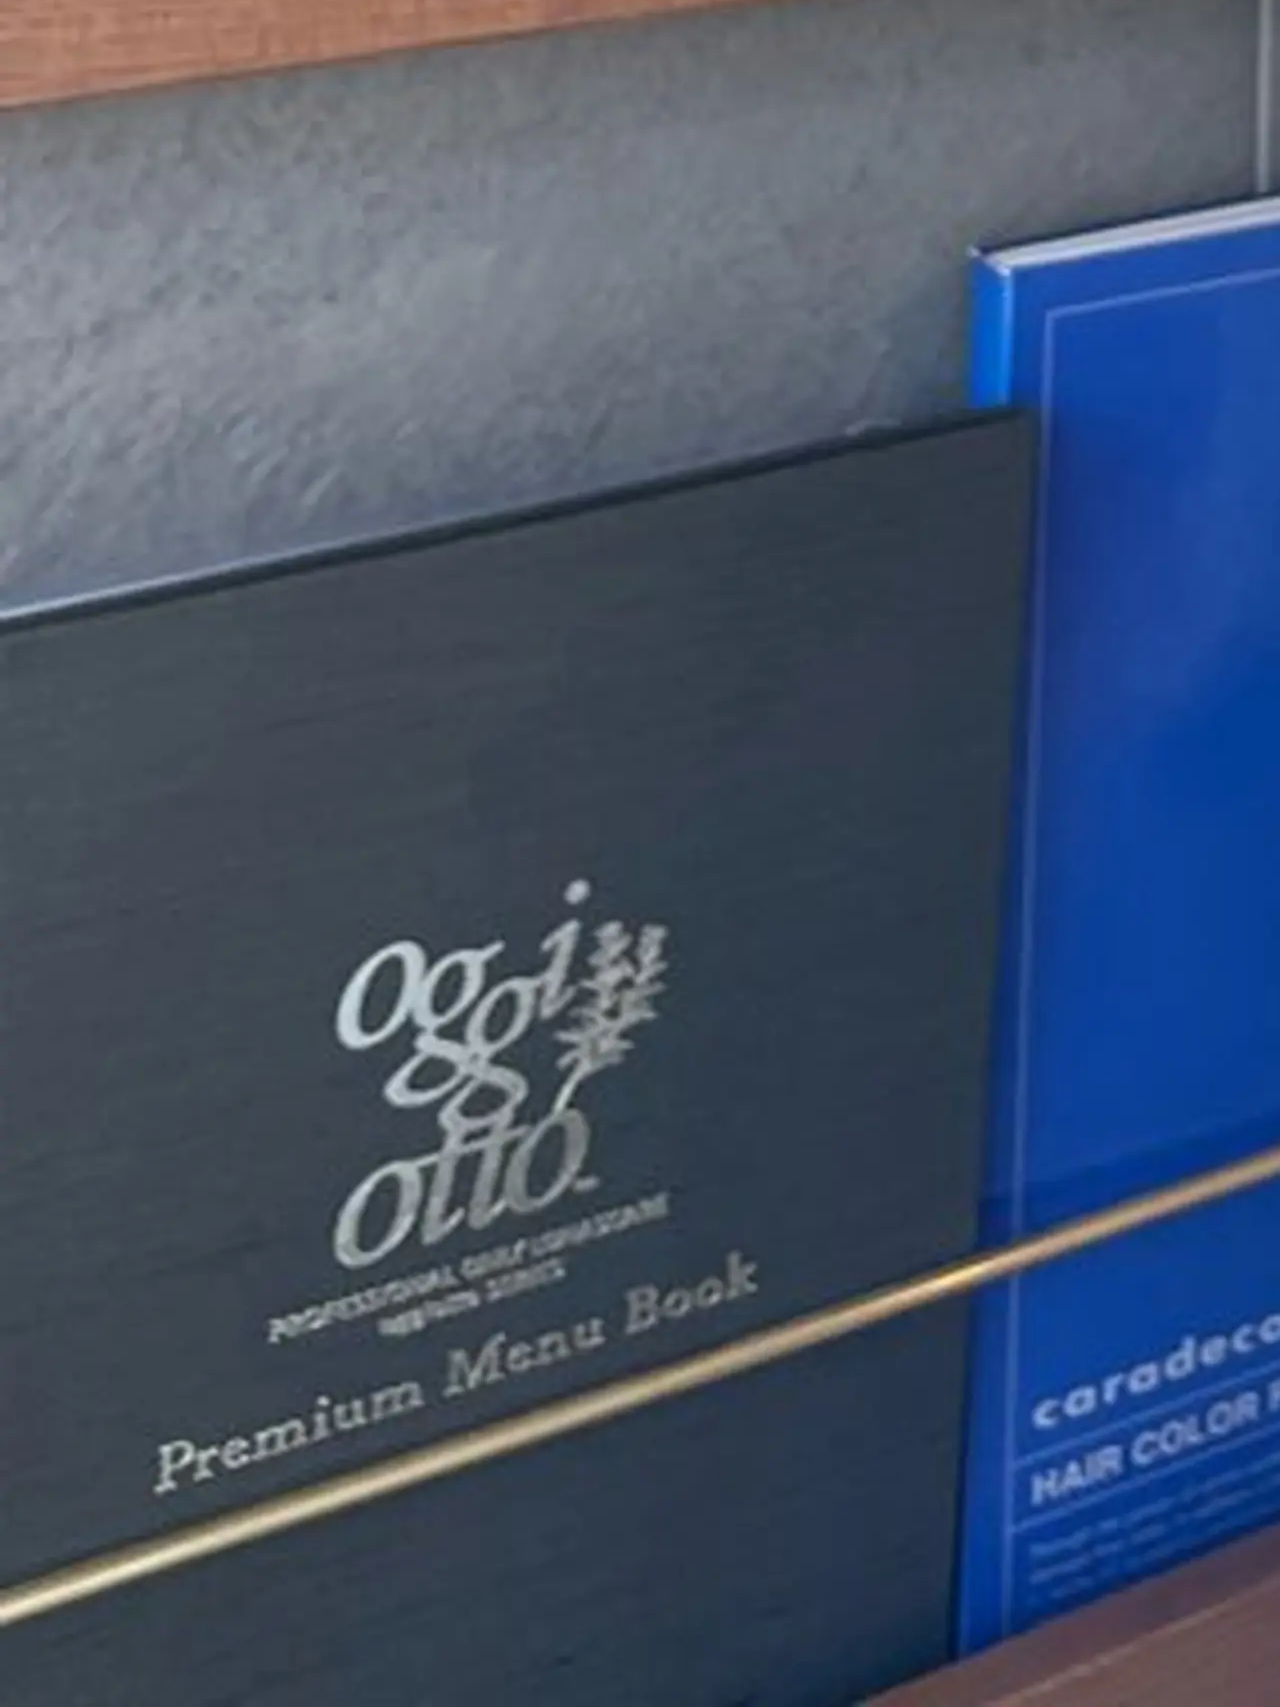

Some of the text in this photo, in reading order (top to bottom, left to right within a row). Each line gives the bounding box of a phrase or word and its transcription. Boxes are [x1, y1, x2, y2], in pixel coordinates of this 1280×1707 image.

[153, 1381, 425, 1494] Premium
[442, 1316, 607, 1399] Menu
[623, 1249, 759, 1335] Book
[1030, 1445, 1123, 1506] HAIR
[1130, 1391, 1261, 1466] COLOR
